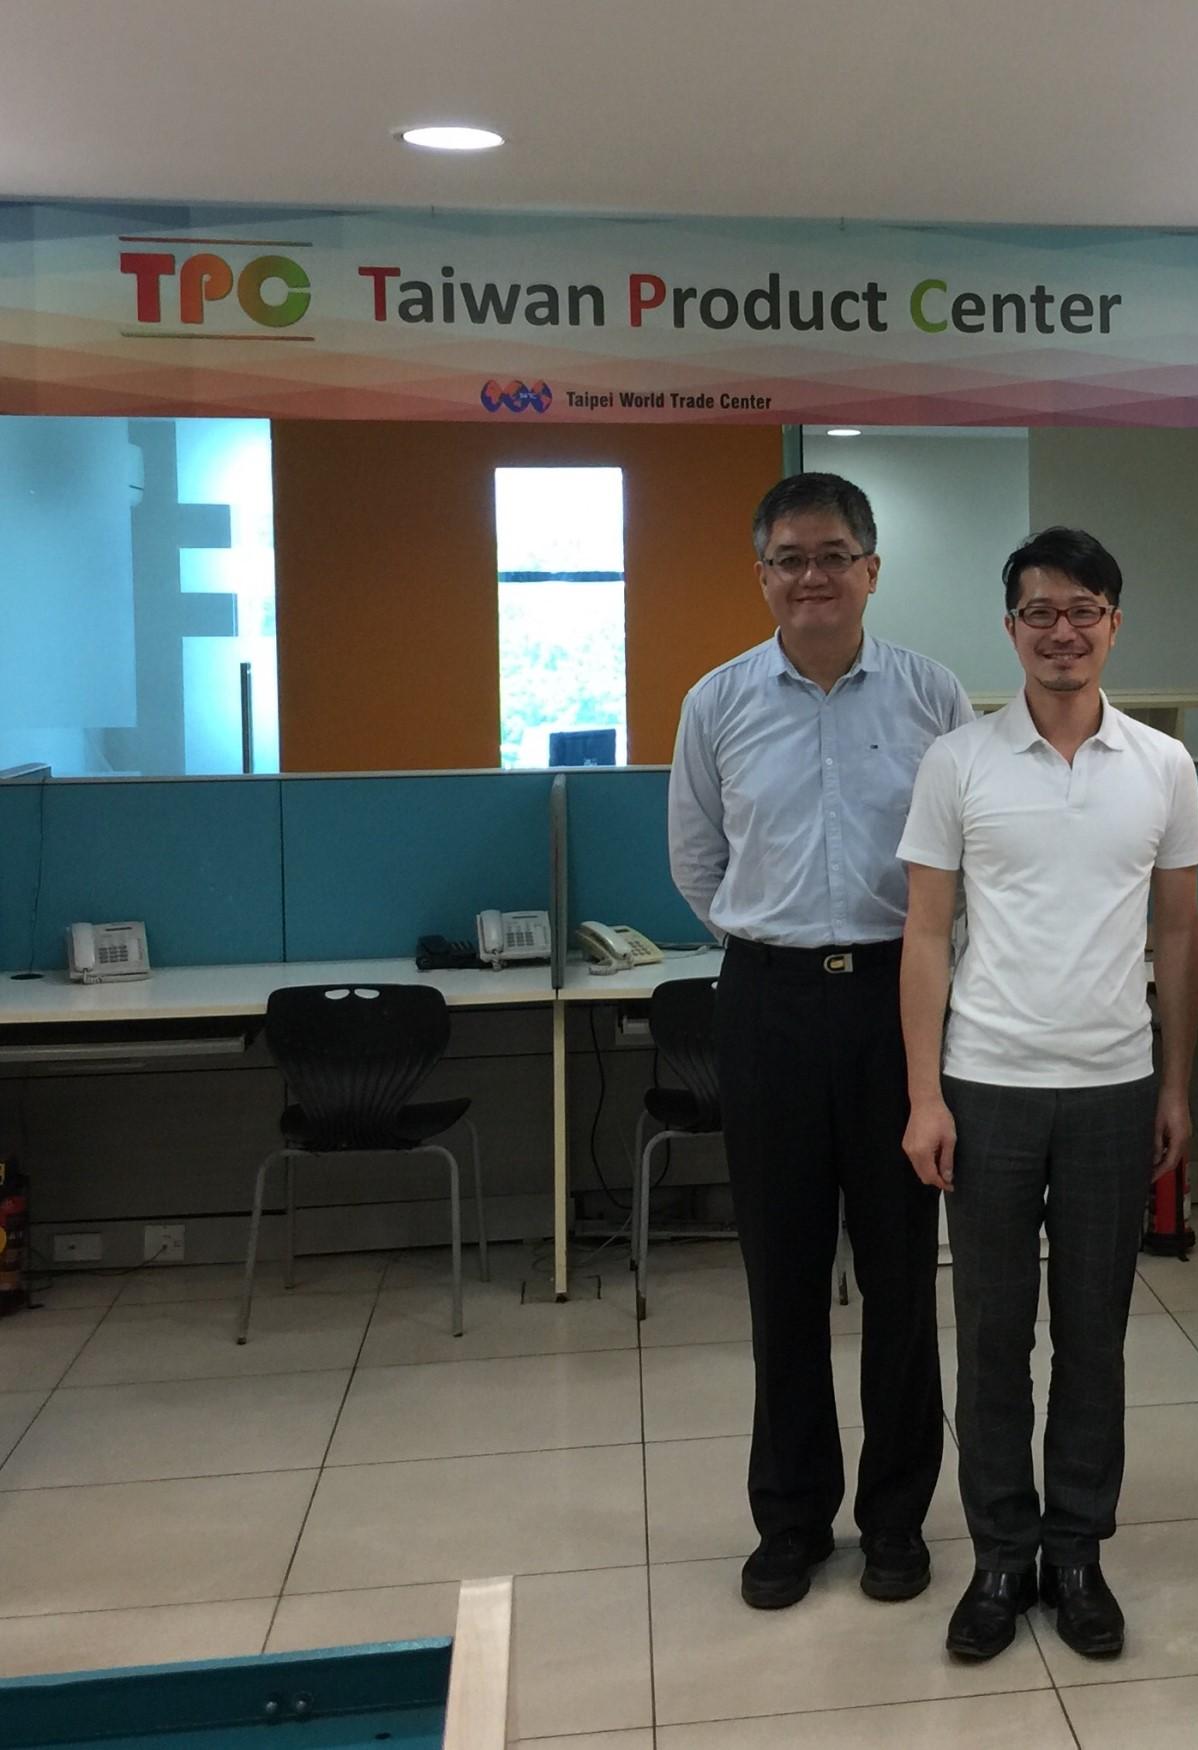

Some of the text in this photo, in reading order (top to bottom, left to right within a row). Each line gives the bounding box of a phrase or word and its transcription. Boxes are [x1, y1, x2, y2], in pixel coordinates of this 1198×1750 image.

[120, 252, 311, 328] TPC
[358, 265, 1122, 334] Taiwan Product Center
[566, 391, 772, 411] Taipei World Trade Center
